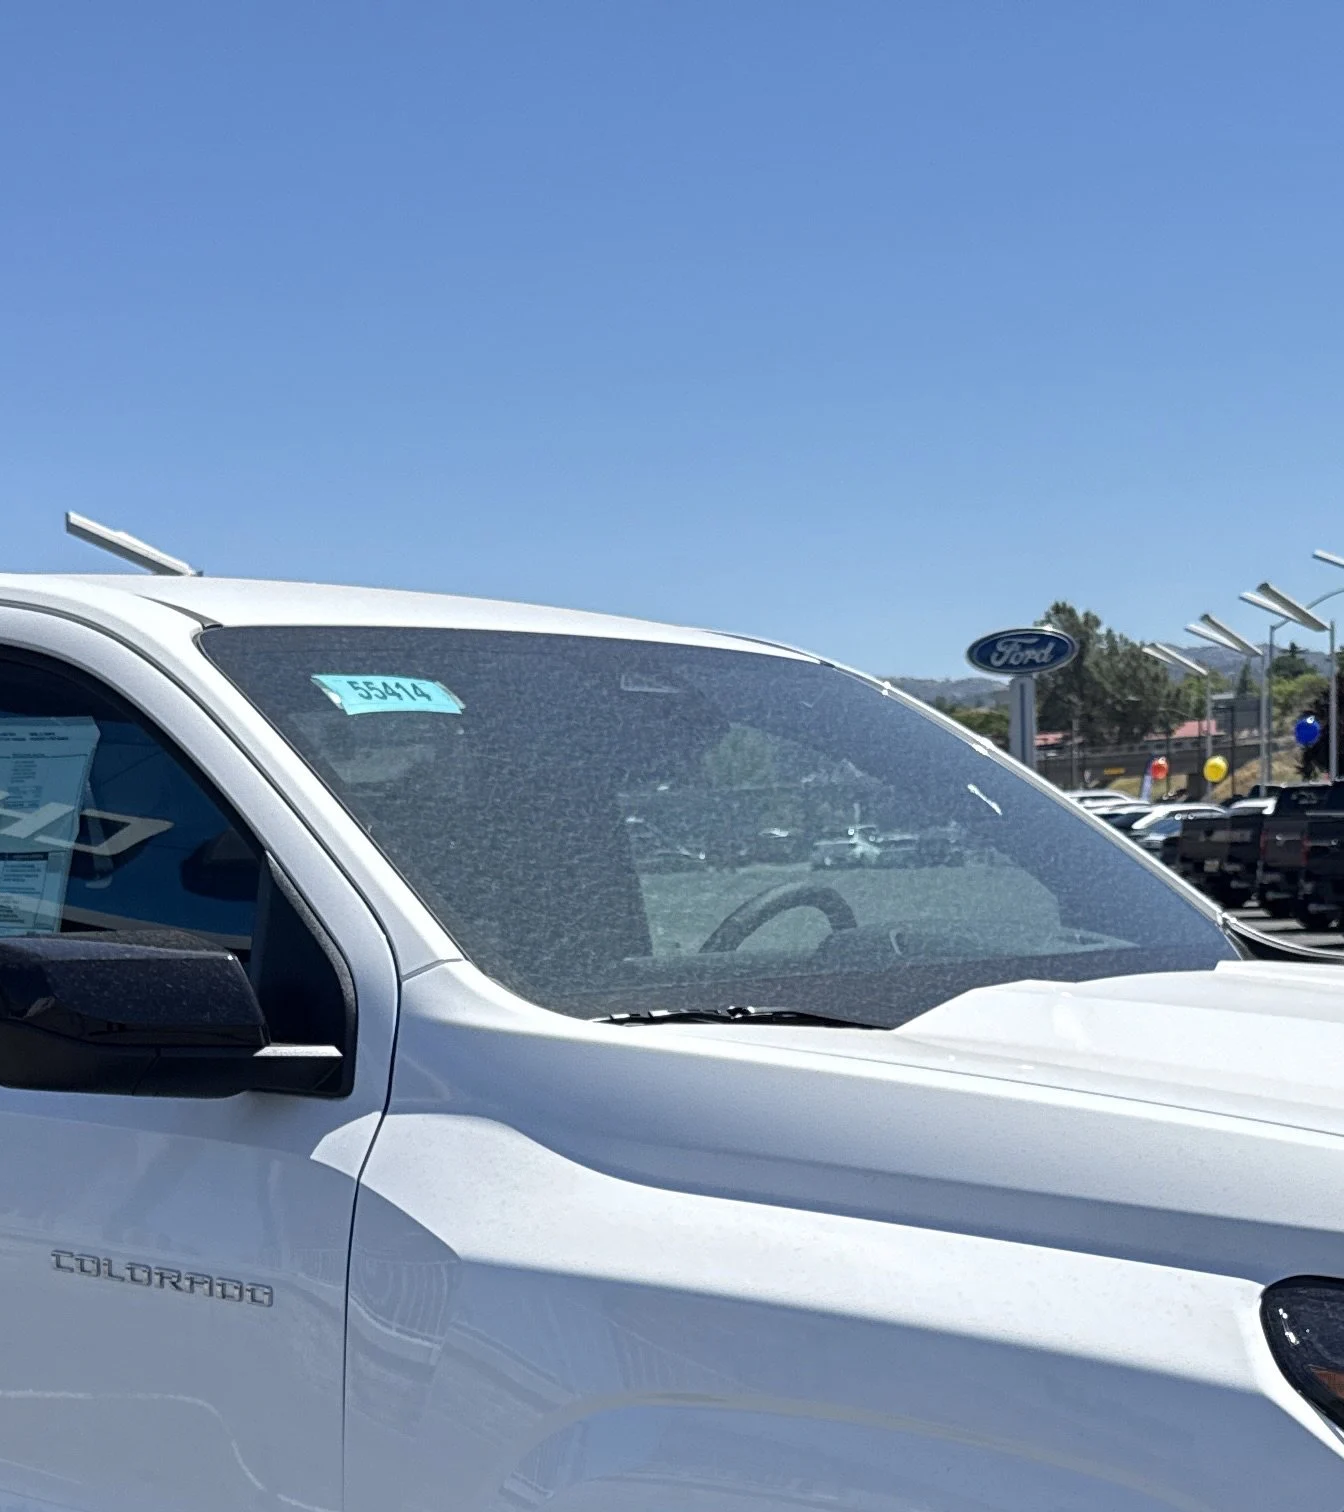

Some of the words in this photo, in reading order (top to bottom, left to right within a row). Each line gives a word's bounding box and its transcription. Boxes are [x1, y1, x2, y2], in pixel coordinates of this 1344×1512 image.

[990, 637, 1055, 667] Ford
[347, 681, 431, 701] 55414
[51, 1250, 274, 1307] COLORADO
